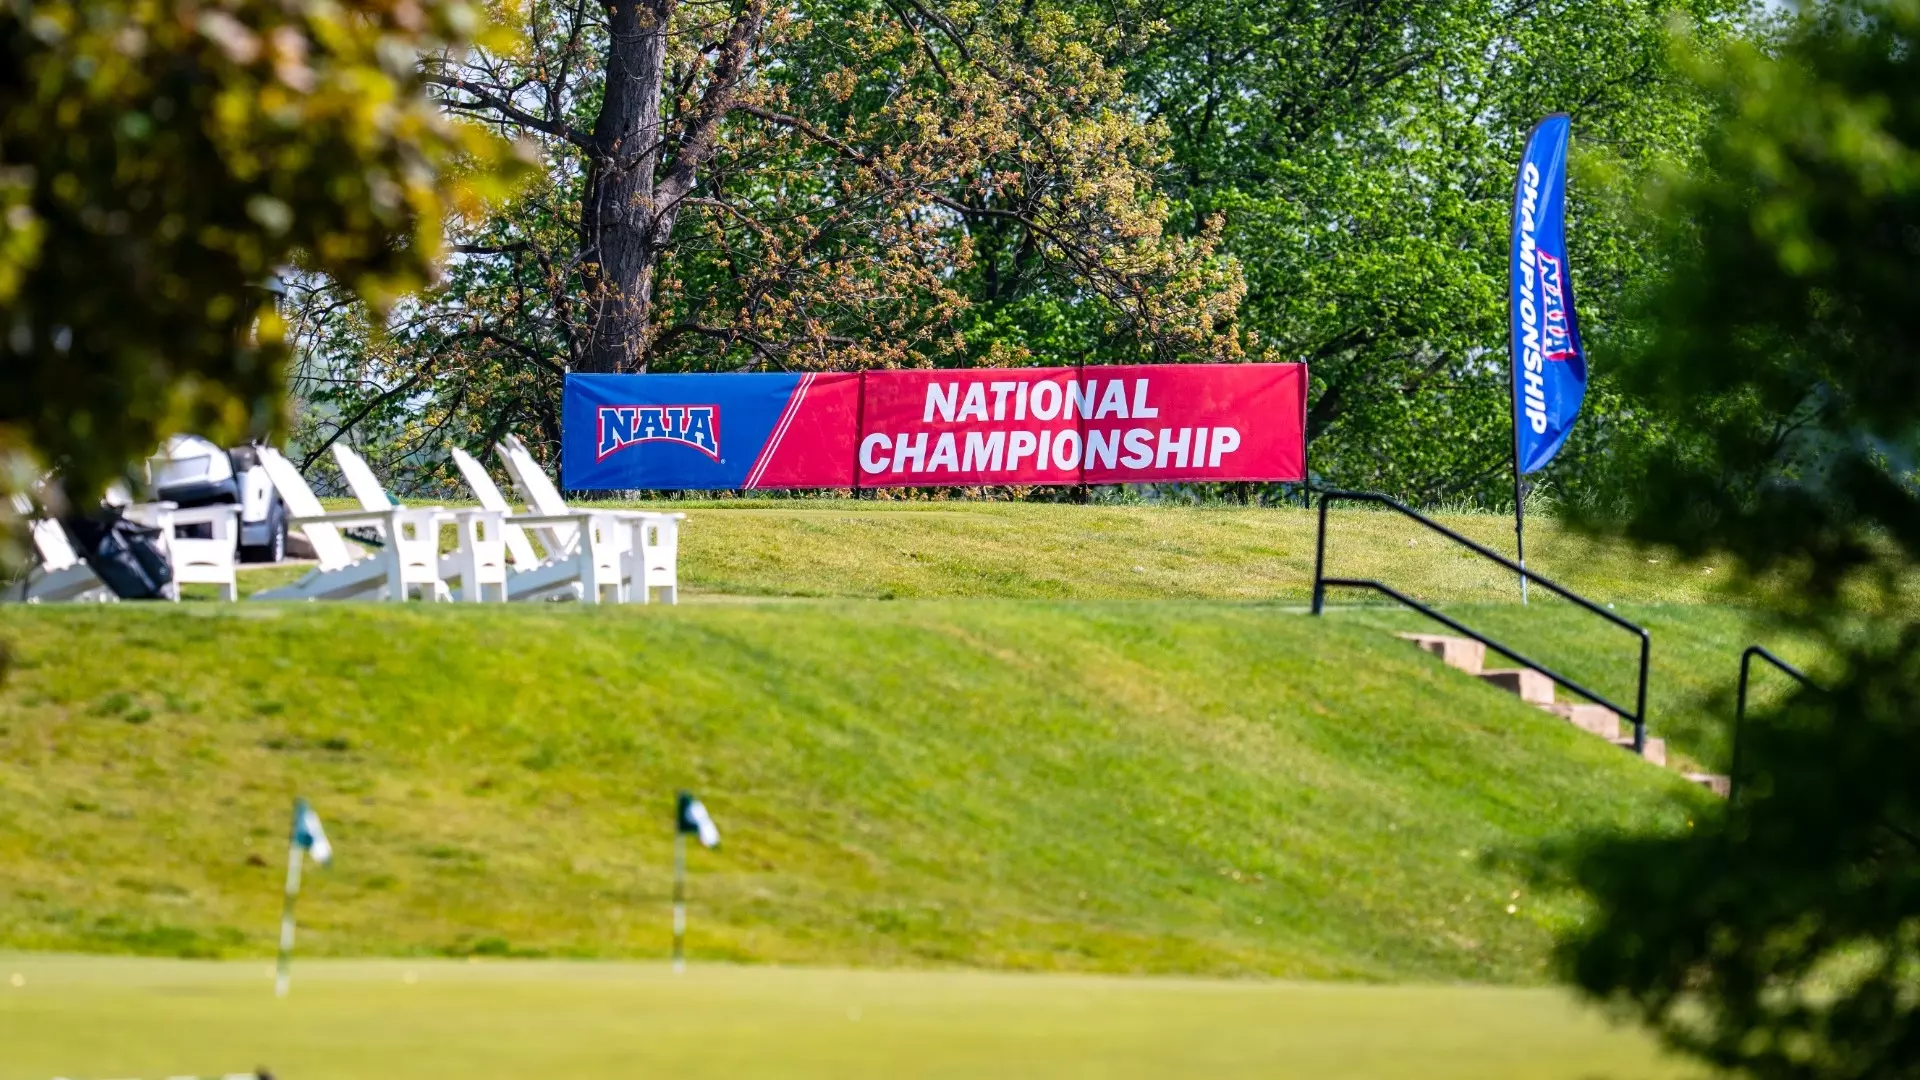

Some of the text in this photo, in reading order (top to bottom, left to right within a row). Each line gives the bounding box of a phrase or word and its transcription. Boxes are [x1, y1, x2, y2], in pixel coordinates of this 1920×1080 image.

[1519, 161, 1547, 434] CHAMPIONSHIP
[1538, 250, 1575, 357] NAIA
[923, 378, 1159, 423] NATIONAL
[598, 407, 718, 459] NAIA
[859, 427, 1241, 474] CHAMPIONSHIP
